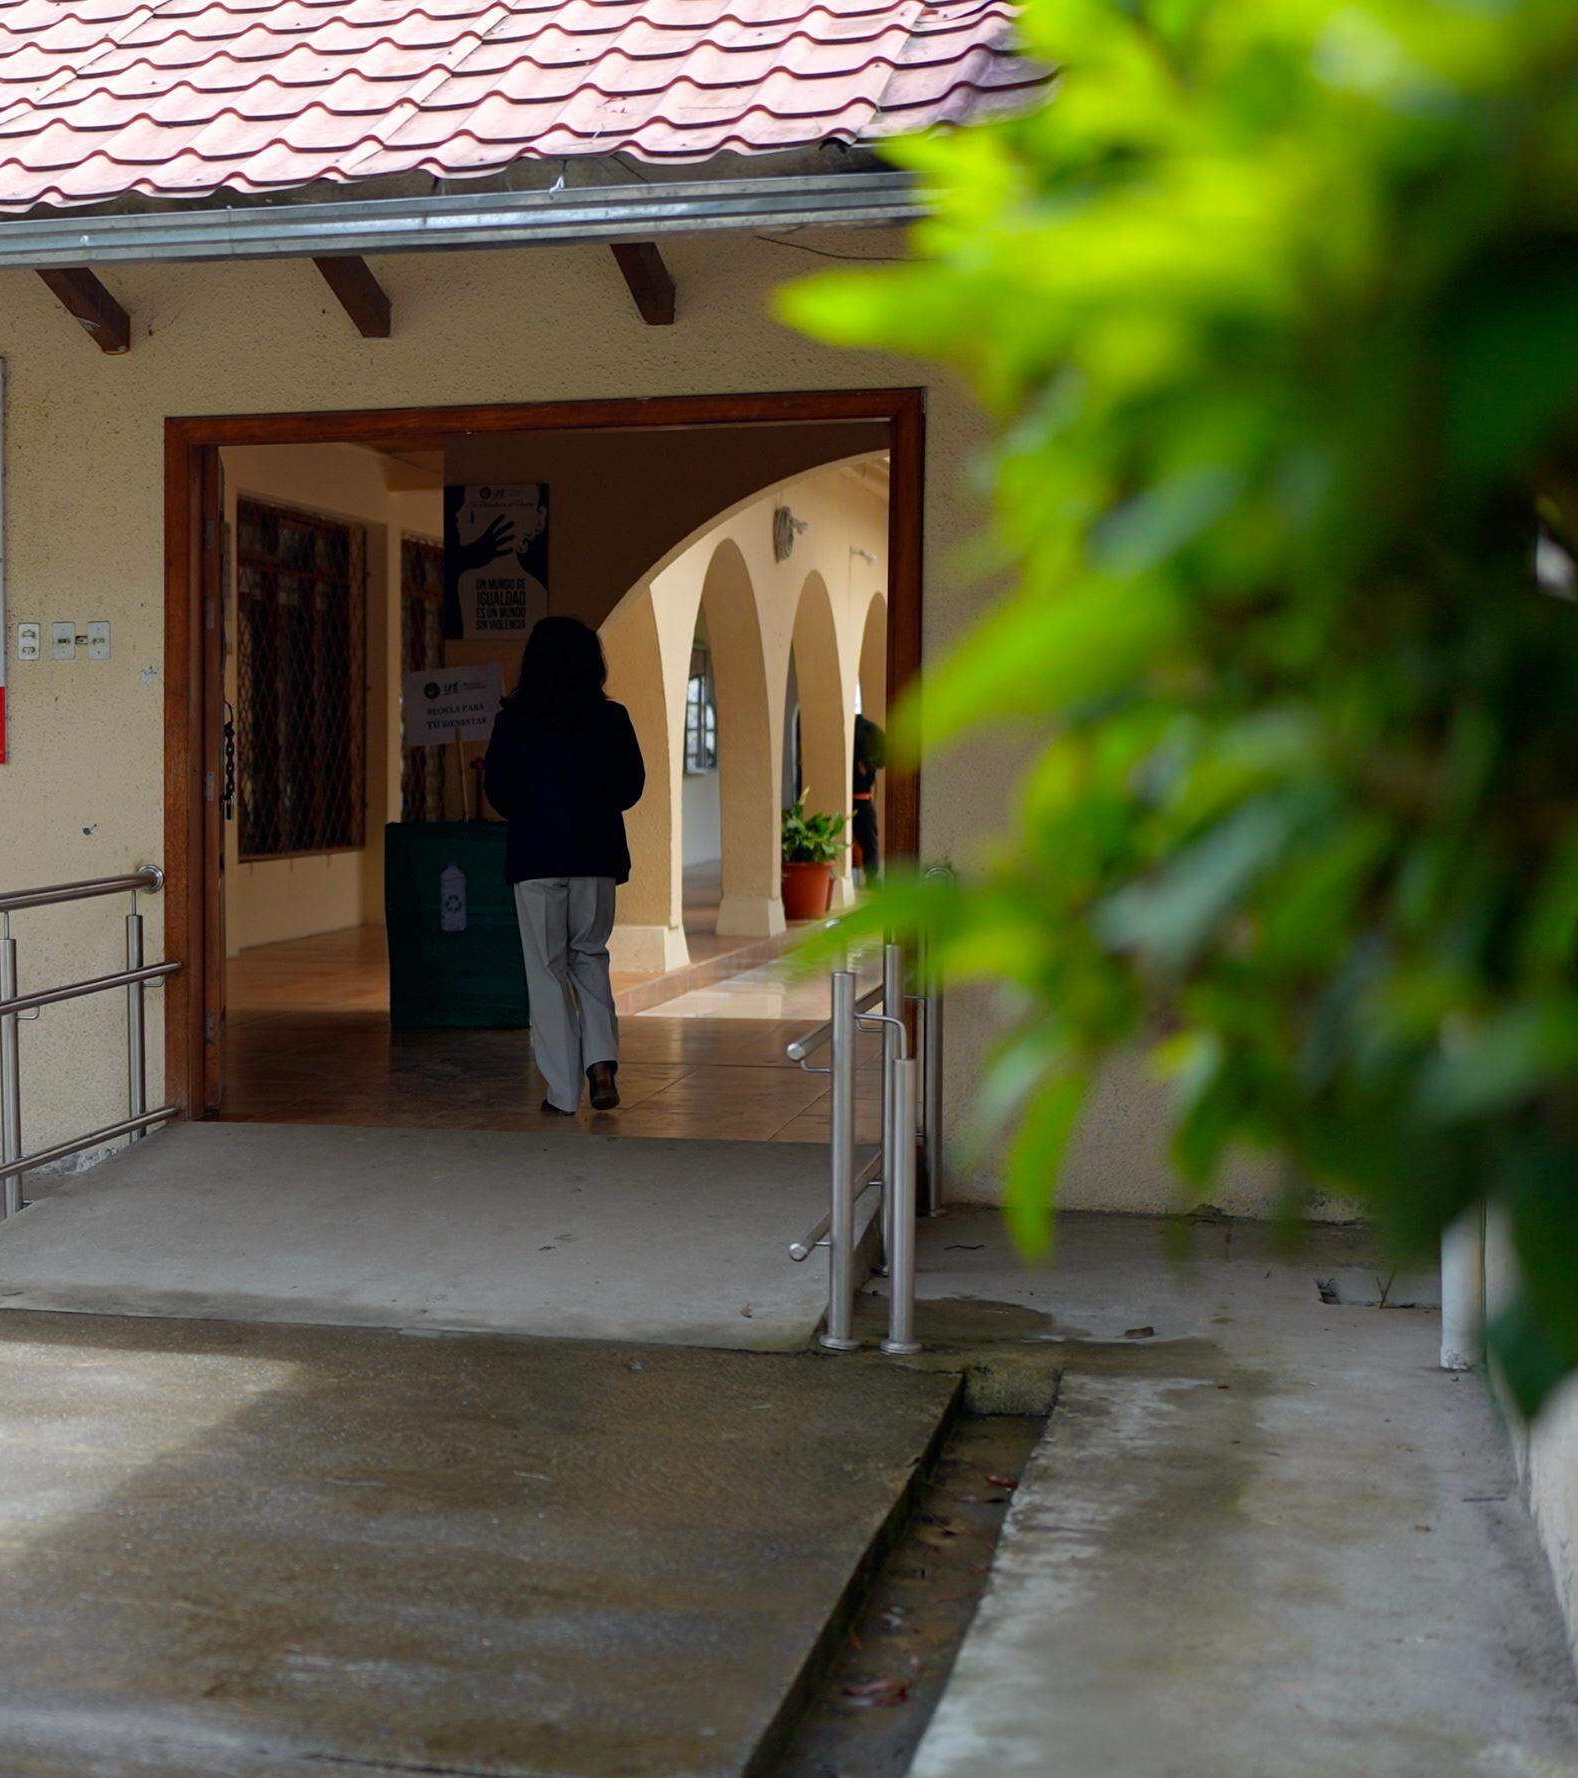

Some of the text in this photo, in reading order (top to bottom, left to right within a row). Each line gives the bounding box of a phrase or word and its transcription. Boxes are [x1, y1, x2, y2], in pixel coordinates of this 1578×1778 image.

[477, 591, 526, 606] IGUALDAD
[476, 607, 486, 618] ES
[487, 607, 497, 618] UN
[462, 703, 486, 712] PARA
